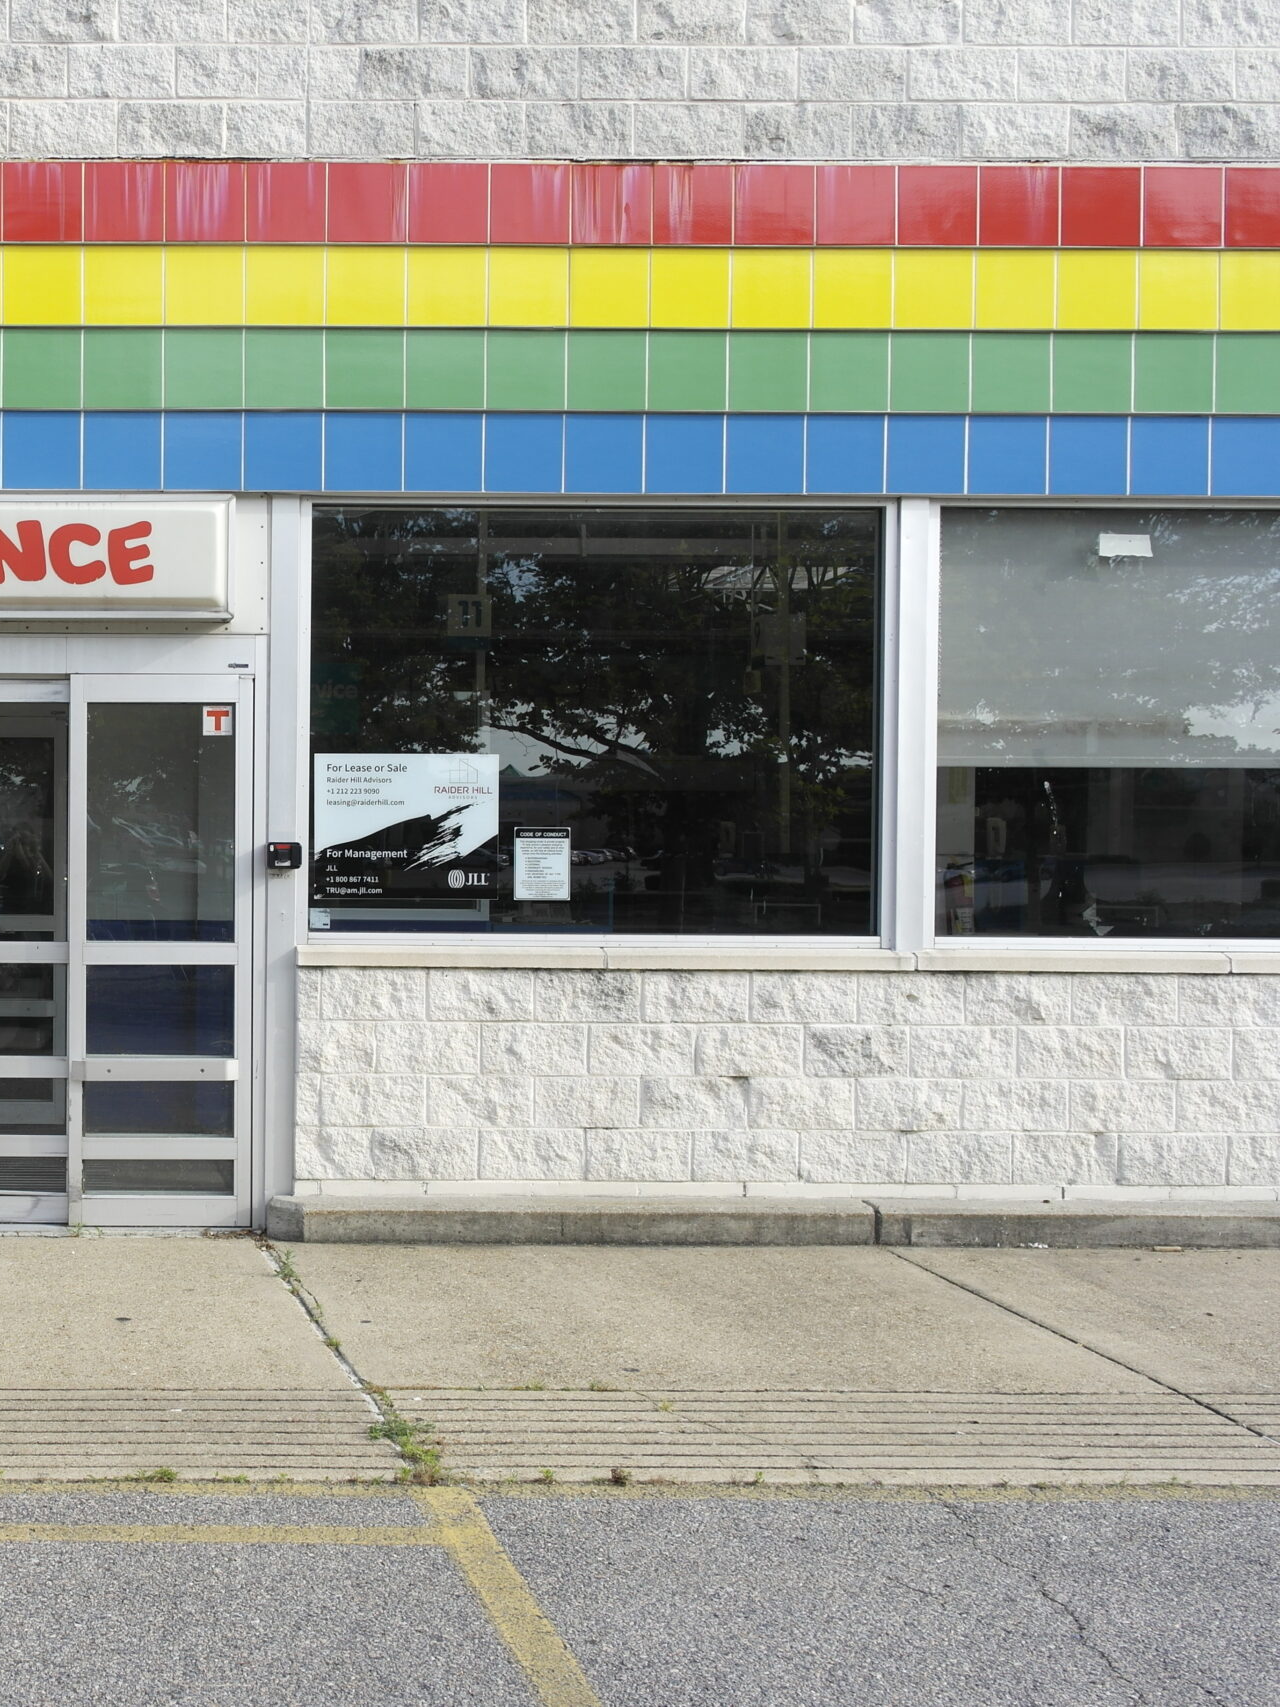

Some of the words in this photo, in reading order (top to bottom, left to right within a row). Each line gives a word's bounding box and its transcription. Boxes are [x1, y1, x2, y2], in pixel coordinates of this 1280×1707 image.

[206, 710, 230, 731] T
[326, 763, 343, 773] For
[344, 763, 372, 773] Lease
[374, 765, 385, 773] or
[387, 763, 408, 773] Sale
[326, 776, 349, 784] Raider
[350, 776, 362, 784] Hill
[363, 776, 393, 784] Advisors
[434, 786, 470, 794] RAIDER
[471, 786, 493, 795] HILL
[326, 799, 405, 808] leasing@raiderhill.com
[326, 849, 343, 858] For
[344, 849, 408, 861] Management
[465, 872, 489, 886] JLL
[326, 887, 383, 896] TRU@am.jll.com
